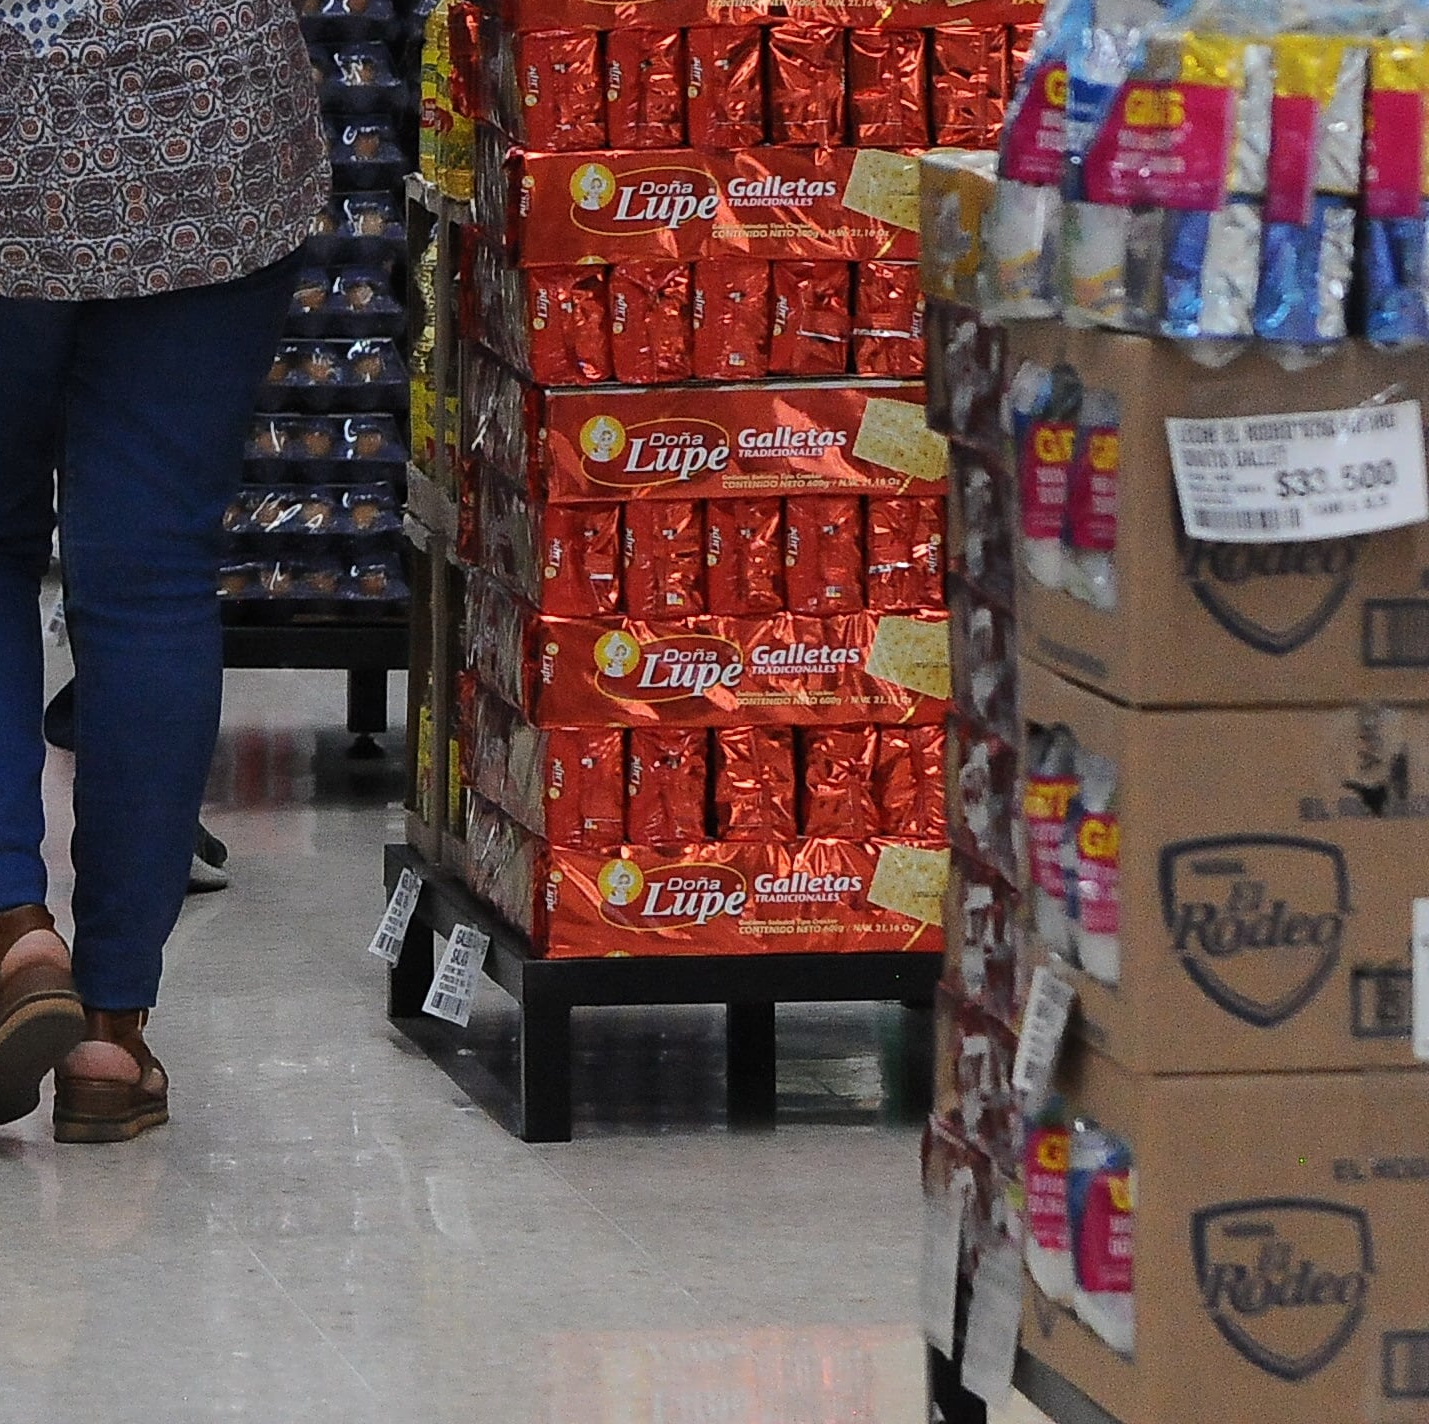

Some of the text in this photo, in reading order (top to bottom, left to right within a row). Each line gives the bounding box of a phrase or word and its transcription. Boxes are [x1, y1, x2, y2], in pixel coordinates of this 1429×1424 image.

[848, 0, 873, 8] 21.16
[527, 64, 539, 94] Lupe
[611, 59, 622, 89] Lupe
[692, 56, 703, 87] Lupe
[638, 179, 693, 195] Doña
[728, 177, 836, 197] Galletas
[613, 186, 719, 229] Lupe
[728, 198, 813, 207] TRADICIONALES
[712, 230, 768, 239] CONTENIDO
[770, 229, 795, 238] NETO
[537, 287, 549, 318] Lupe
[615, 292, 626, 324] Lupe
[776, 293, 789, 327] Lupe
[648, 430, 703, 447] Doña
[738, 428, 847, 448] Galletas
[738, 448, 824, 458] TRADICIONALES
[623, 437, 730, 480] Lupe
[722, 480, 778, 489] CONTENIDO
[779, 480, 806, 489] NETO
[887, 477, 901, 486] Oz
[552, 536, 562, 567] Lupe
[710, 524, 721, 555] Lupe
[787, 525, 799, 556] Lupe
[542, 654, 554, 684] Lupe
[662, 647, 717, 663] Doña
[751, 644, 860, 665] Galletas
[751, 665, 836, 674] TRADICIONALES
[638, 653, 741, 696] Lupe
[736, 696, 791, 705] CONTENIDO
[552, 758, 565, 788] Lupe
[631, 755, 642, 785] Lupe
[546, 882, 557, 912] Lupe
[667, 876, 721, 892] Doña
[754, 872, 862, 893] Galletas
[642, 882, 746, 925] Lupe
[754, 893, 841, 903] TRADICIONALES
[739, 925, 795, 934] CONTENIDO
[796, 924, 822, 933] NETO
[876, 924, 900, 932] 21.16
[902, 923, 915, 932] Oz
[1175, 899, 1344, 957] Rodeo
[1205, 1260, 1367, 1317] Rodeo
